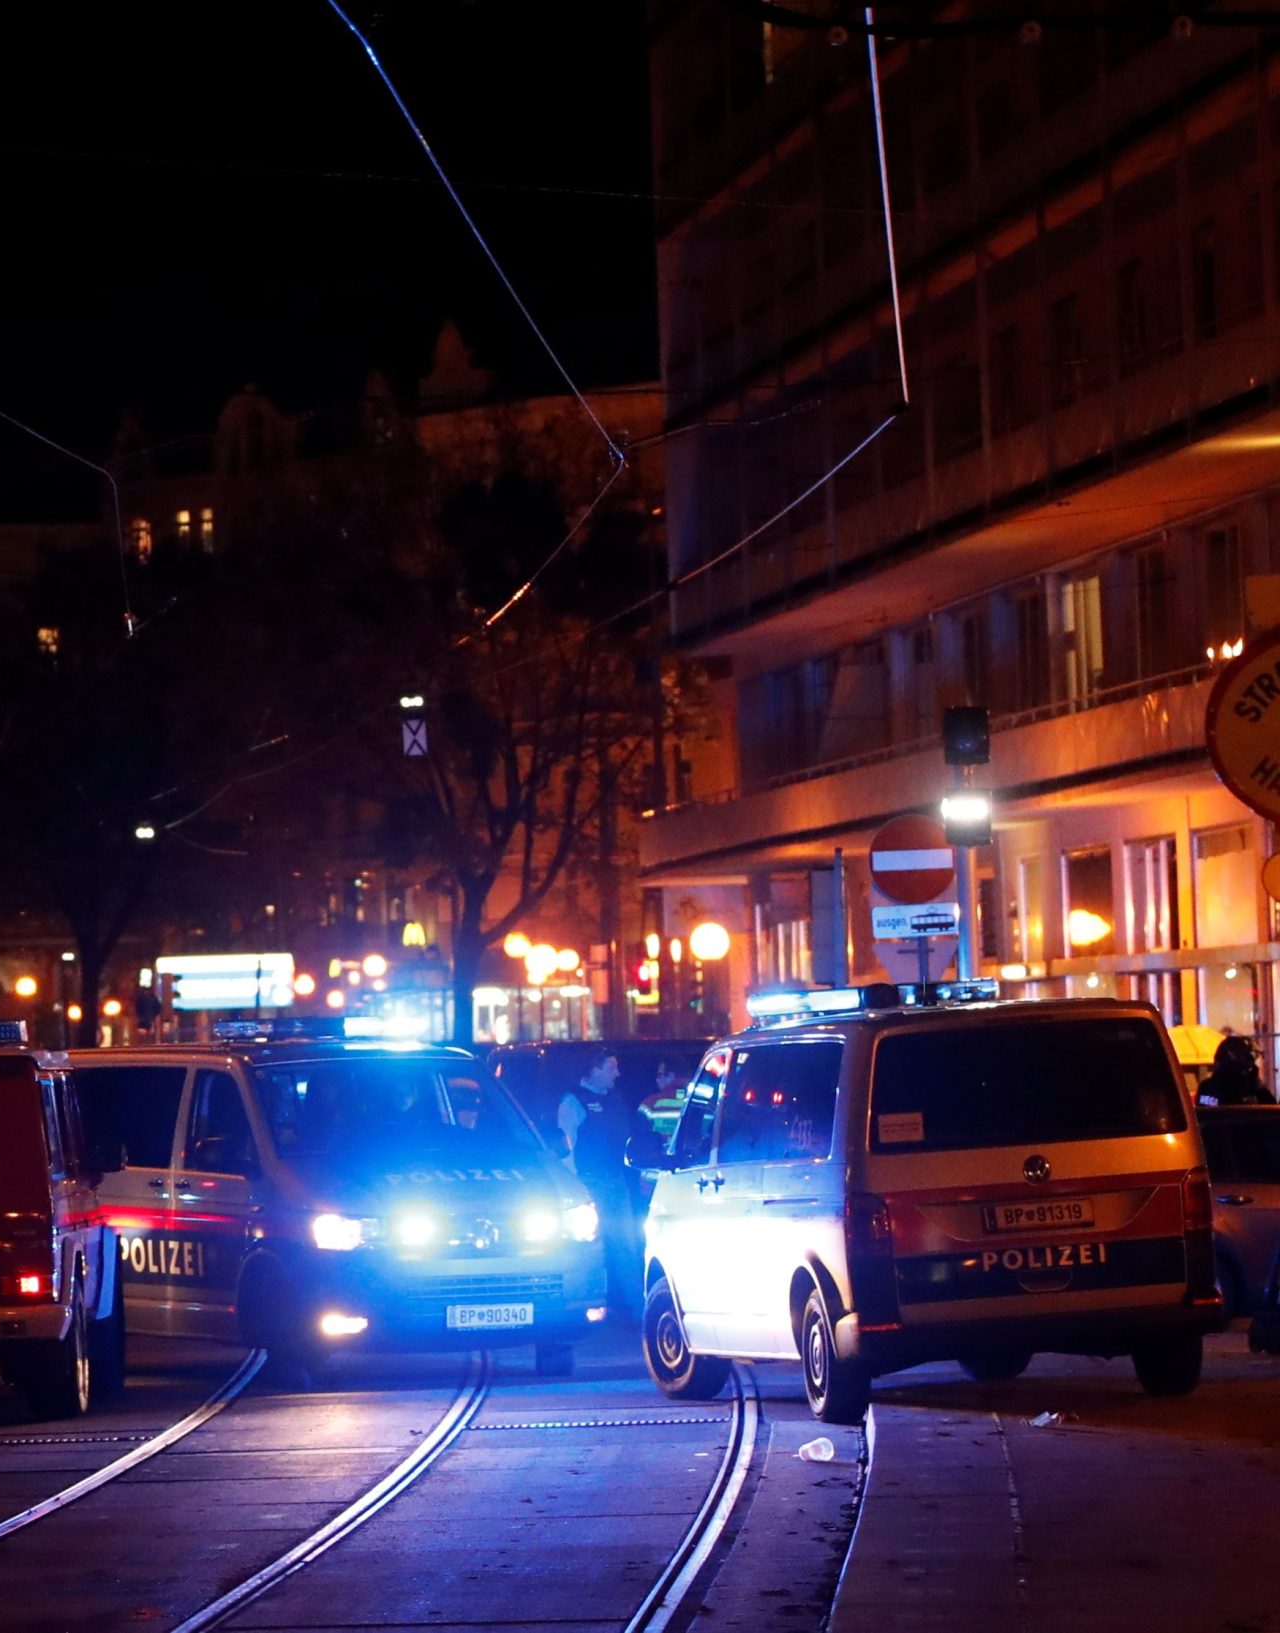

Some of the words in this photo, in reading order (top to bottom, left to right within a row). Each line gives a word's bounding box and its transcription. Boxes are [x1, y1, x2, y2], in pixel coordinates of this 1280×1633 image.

[1234, 661, 1280, 723] STR
[385, 1168, 526, 1186] POLIZEI
[1036, 1204, 1082, 1221] 91319
[120, 1237, 204, 1277] POLIZEI
[982, 1242, 1107, 1273] POLIZEI
[486, 1307, 527, 1323] 90340
